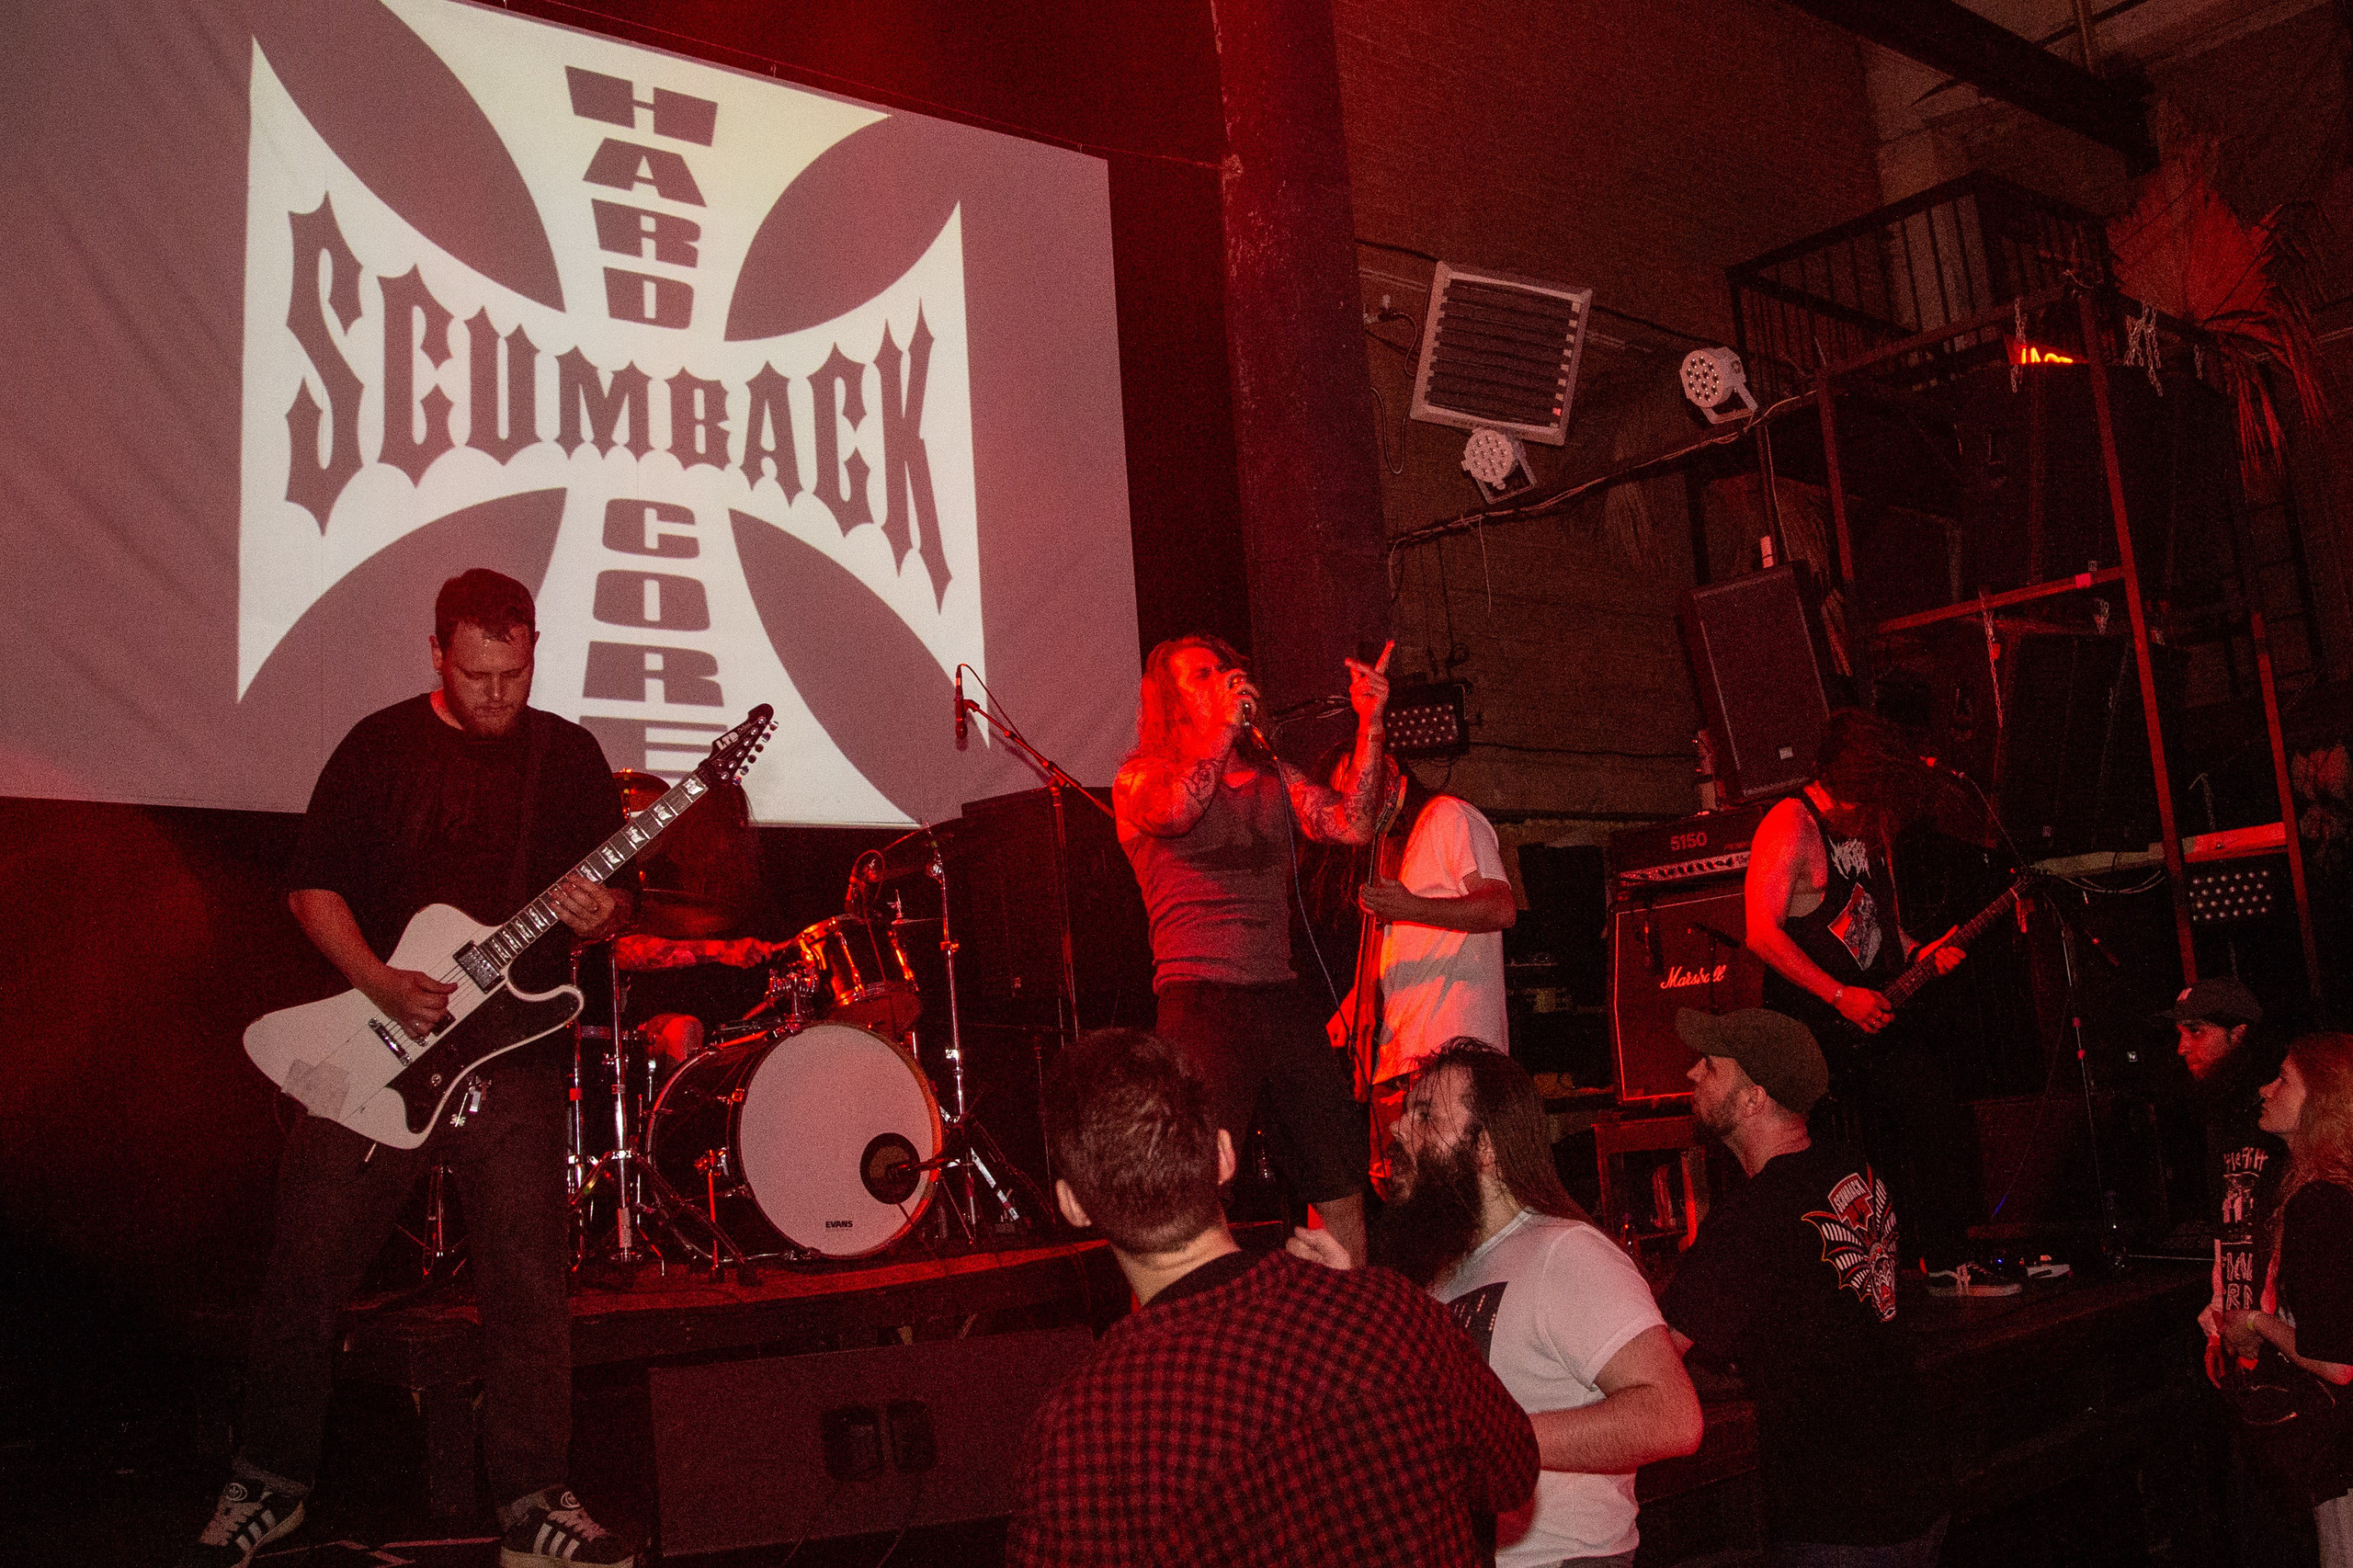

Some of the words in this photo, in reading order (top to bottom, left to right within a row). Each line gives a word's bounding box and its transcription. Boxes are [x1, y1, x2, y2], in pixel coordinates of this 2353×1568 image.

[565, 65, 719, 331] HARD
[285, 189, 953, 616] SCUMBACK
[579, 497, 729, 782] CORE
[715, 731, 739, 751] LTD
[1669, 832, 1708, 851] 5150
[825, 1220, 853, 1228] EVANS
